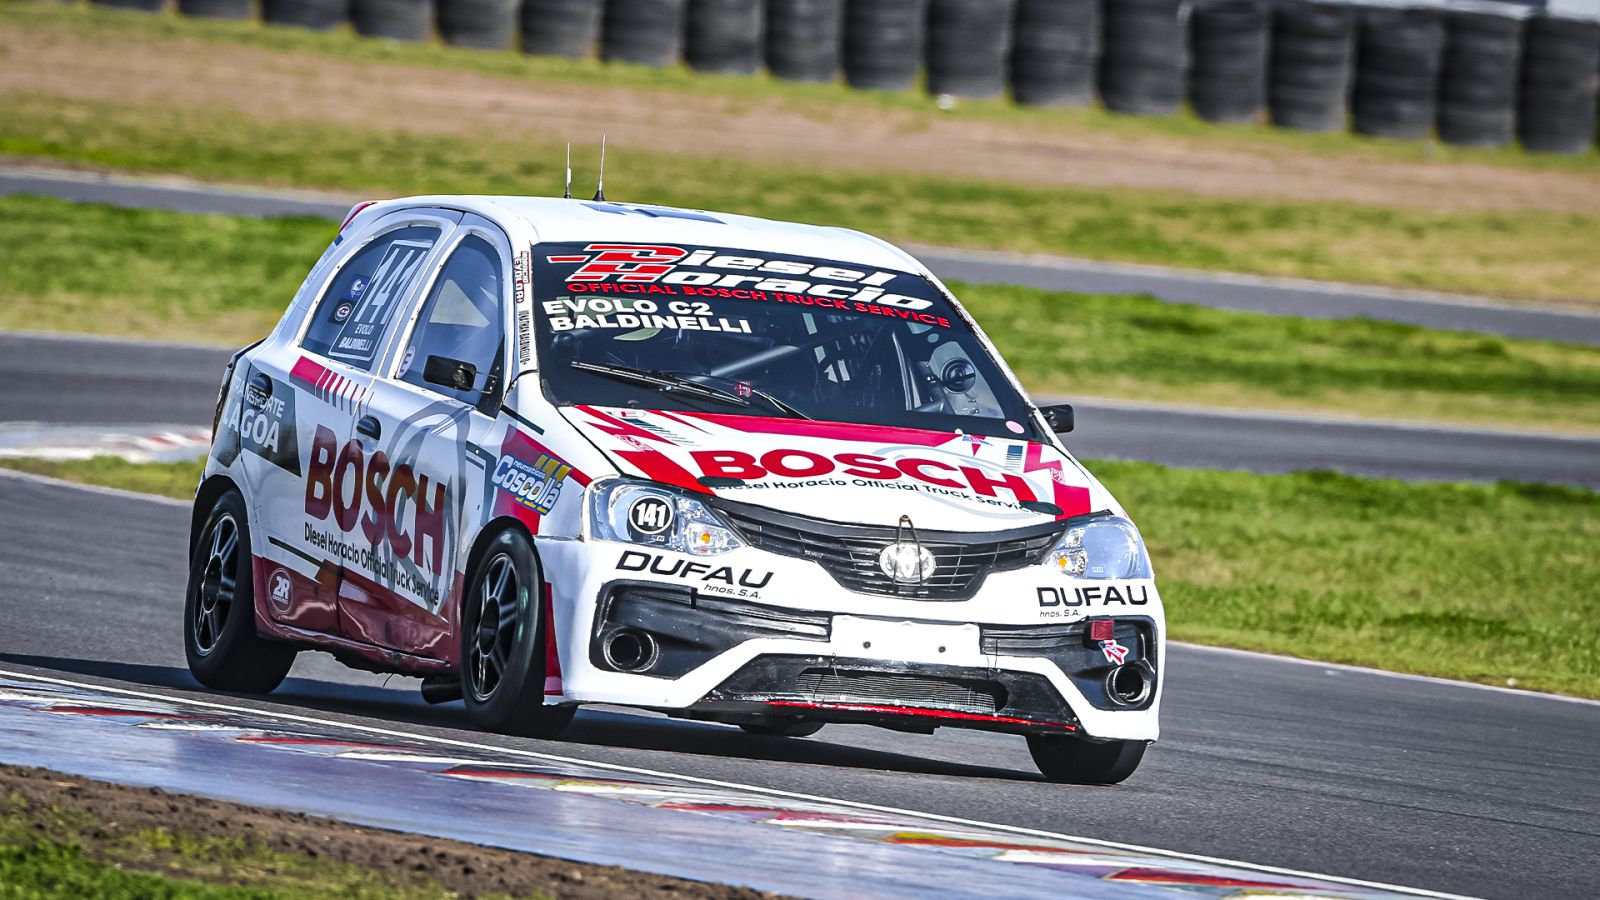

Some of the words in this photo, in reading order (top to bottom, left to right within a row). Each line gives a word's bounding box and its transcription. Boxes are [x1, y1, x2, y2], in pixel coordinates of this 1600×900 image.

[354, 247, 427, 325] 141
[542, 299, 658, 315] EVOLO
[668, 301, 714, 316] C2
[567, 283, 677, 295] OFFICIAL
[684, 285, 768, 301] BOSCH
[771, 292, 850, 310] TRUCK
[854, 302, 951, 328] SERVICE
[354, 323, 374, 335] EVOLO
[549, 314, 752, 333] BALDINELLI
[339, 336, 373, 351] BALDINELLI
[223, 397, 280, 453] LAGOA
[689, 449, 1039, 502] BOSCH
[305, 424, 447, 576] BOSCH
[773, 478, 847, 490] Horacio
[852, 479, 920, 491] Official
[922, 485, 973, 500] Truck
[636, 503, 667, 527] 141
[304, 522, 328, 551] Diesel
[328, 533, 360, 564] Horacio
[361, 548, 389, 579] Official
[389, 561, 411, 591] Truck
[411, 573, 440, 606] Service
[615, 550, 774, 589] DUFAU
[273, 576, 290, 600] 2R
[704, 583, 736, 595] hnos.
[738, 588, 762, 600] S.A.
[1037, 585, 1148, 607] DUFAU
[1039, 610, 1062, 618] hnos.
[1063, 609, 1081, 617] S.A.
